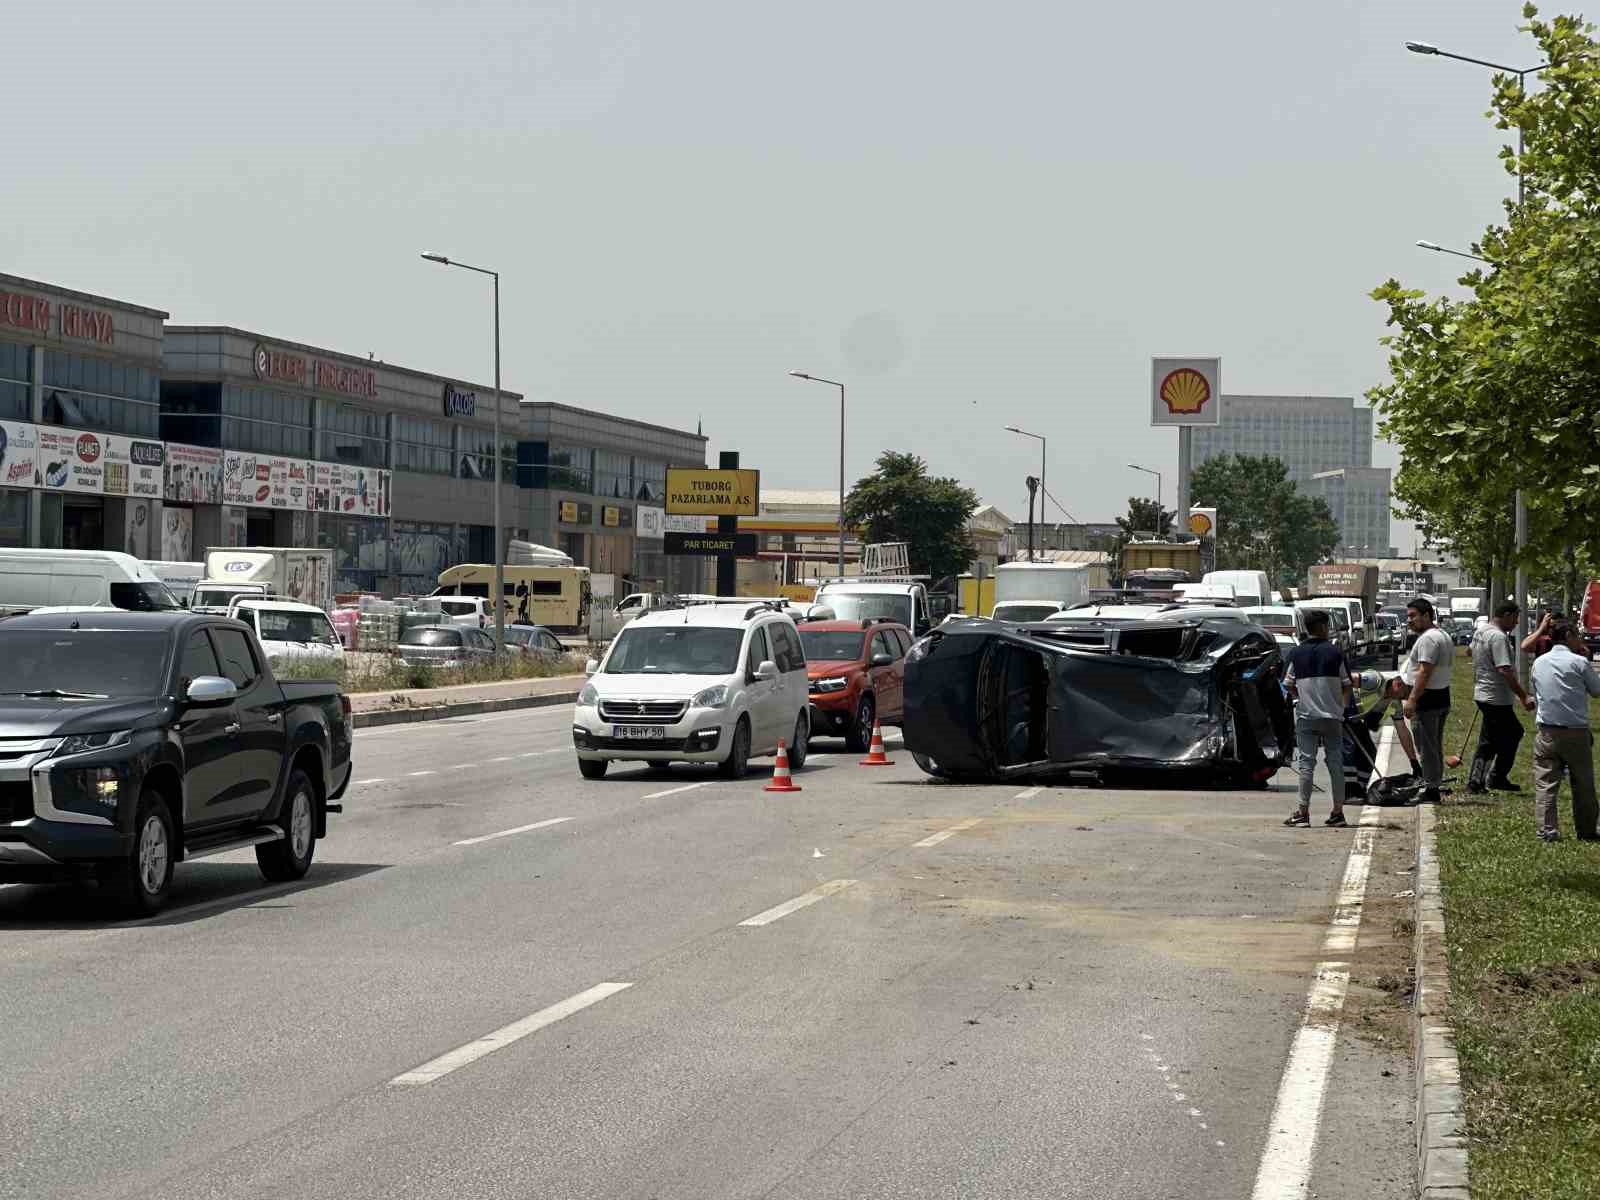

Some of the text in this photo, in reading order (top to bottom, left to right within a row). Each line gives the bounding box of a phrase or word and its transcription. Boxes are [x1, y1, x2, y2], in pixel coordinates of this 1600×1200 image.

[690, 480, 732, 491] TUBORG
[671, 494, 731, 505] PAZARLAMA
[683, 537, 735, 550] PAR TİCARET
[619, 727, 663, 737] 16 BHY 50
